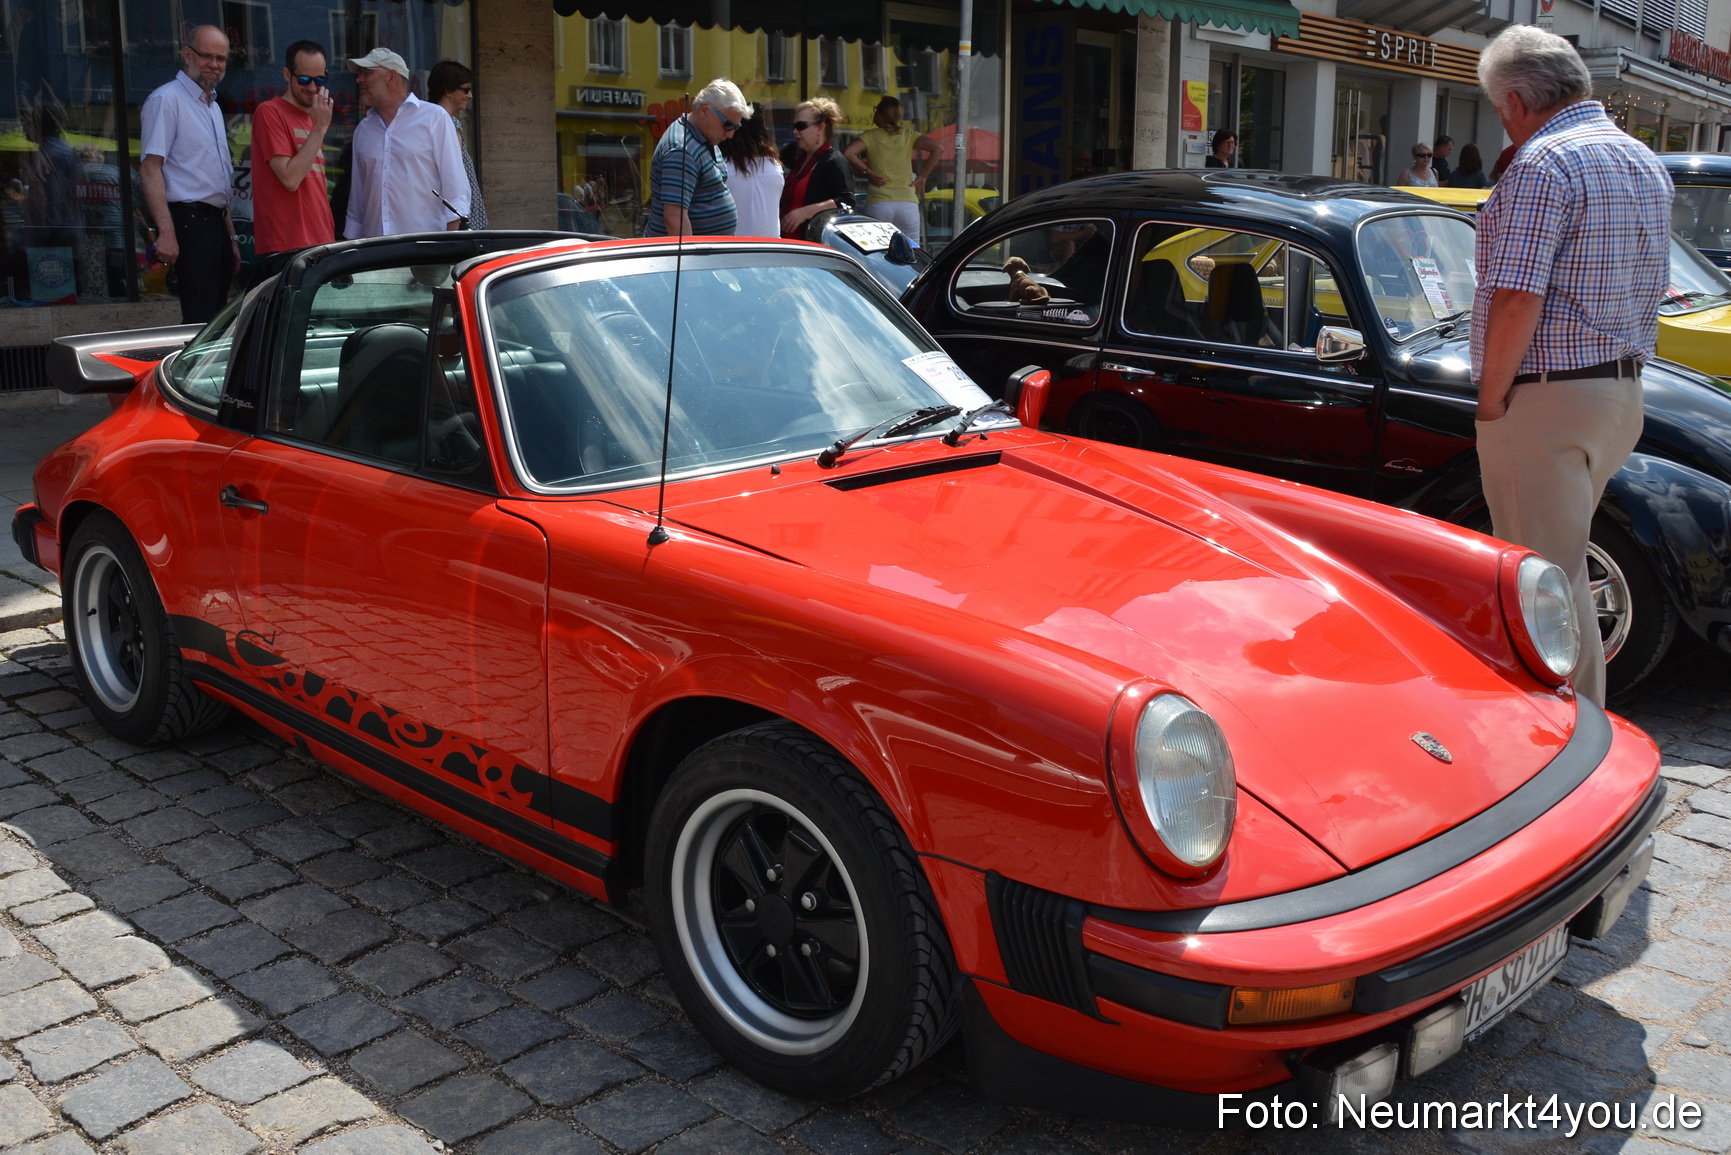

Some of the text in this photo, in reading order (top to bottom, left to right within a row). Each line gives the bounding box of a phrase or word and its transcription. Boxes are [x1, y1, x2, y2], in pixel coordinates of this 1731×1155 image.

[1366, 29, 1438, 67] ESPRIT
[76, 184, 121, 198] MUSTANG
[226, 629, 535, 806] Carrera
